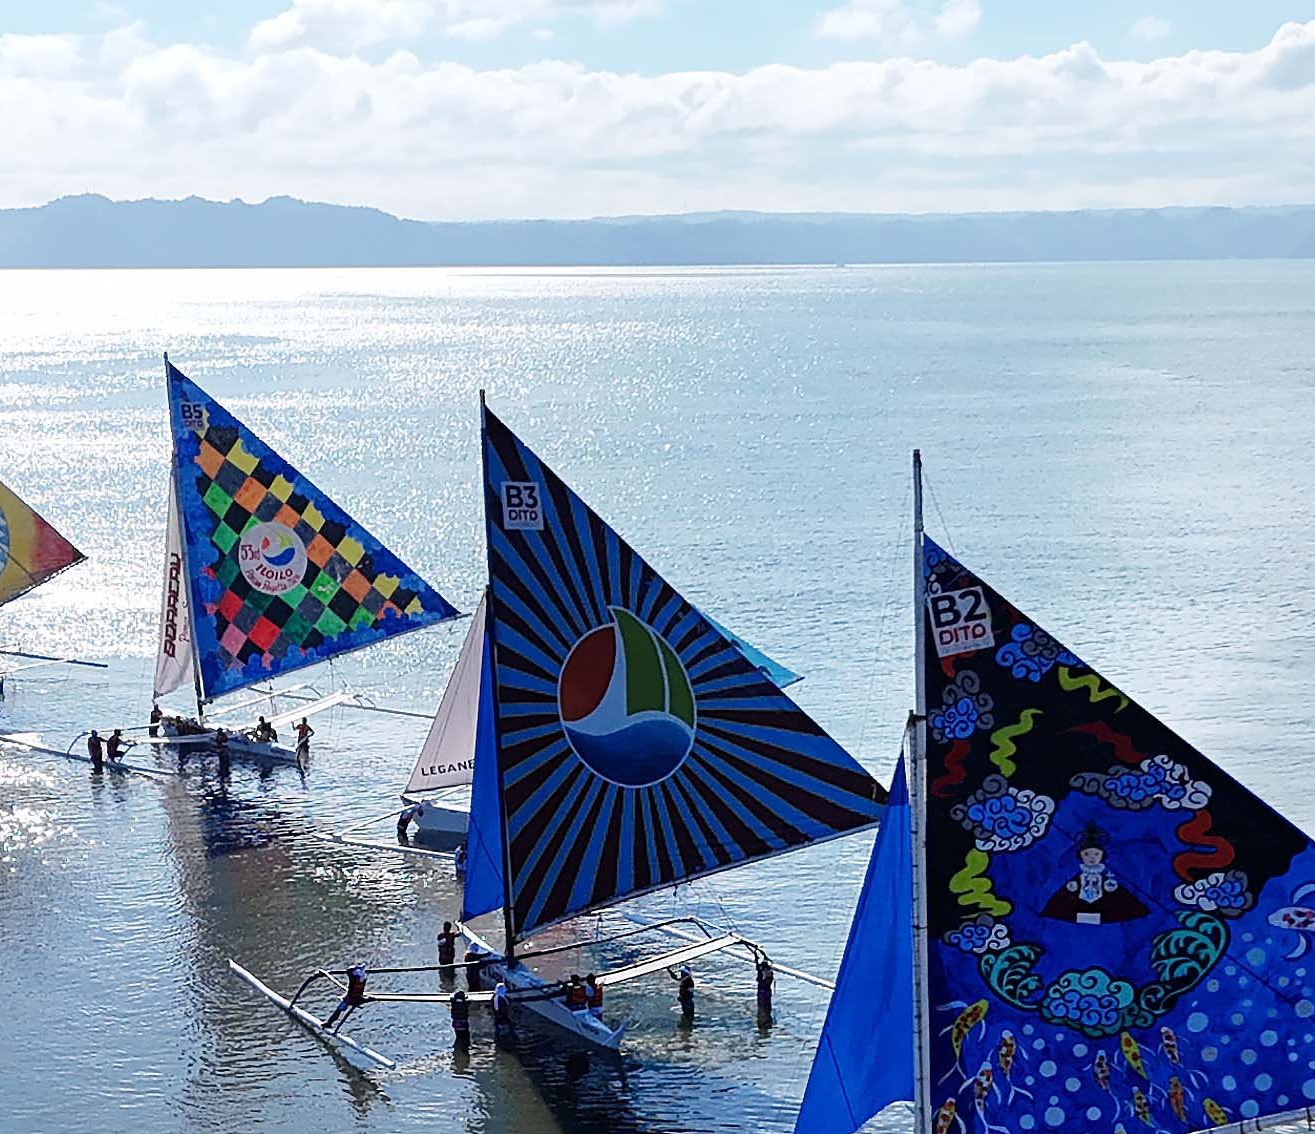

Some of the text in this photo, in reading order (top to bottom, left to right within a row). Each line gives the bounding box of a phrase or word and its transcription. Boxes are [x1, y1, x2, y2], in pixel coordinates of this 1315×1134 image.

[180, 404, 203, 419] B5
[505, 484, 538, 509] B3
[508, 508, 538, 521] DITO
[255, 563, 294, 580] ILOILO
[930, 589, 987, 629] B2
[938, 623, 987, 646] DITO
